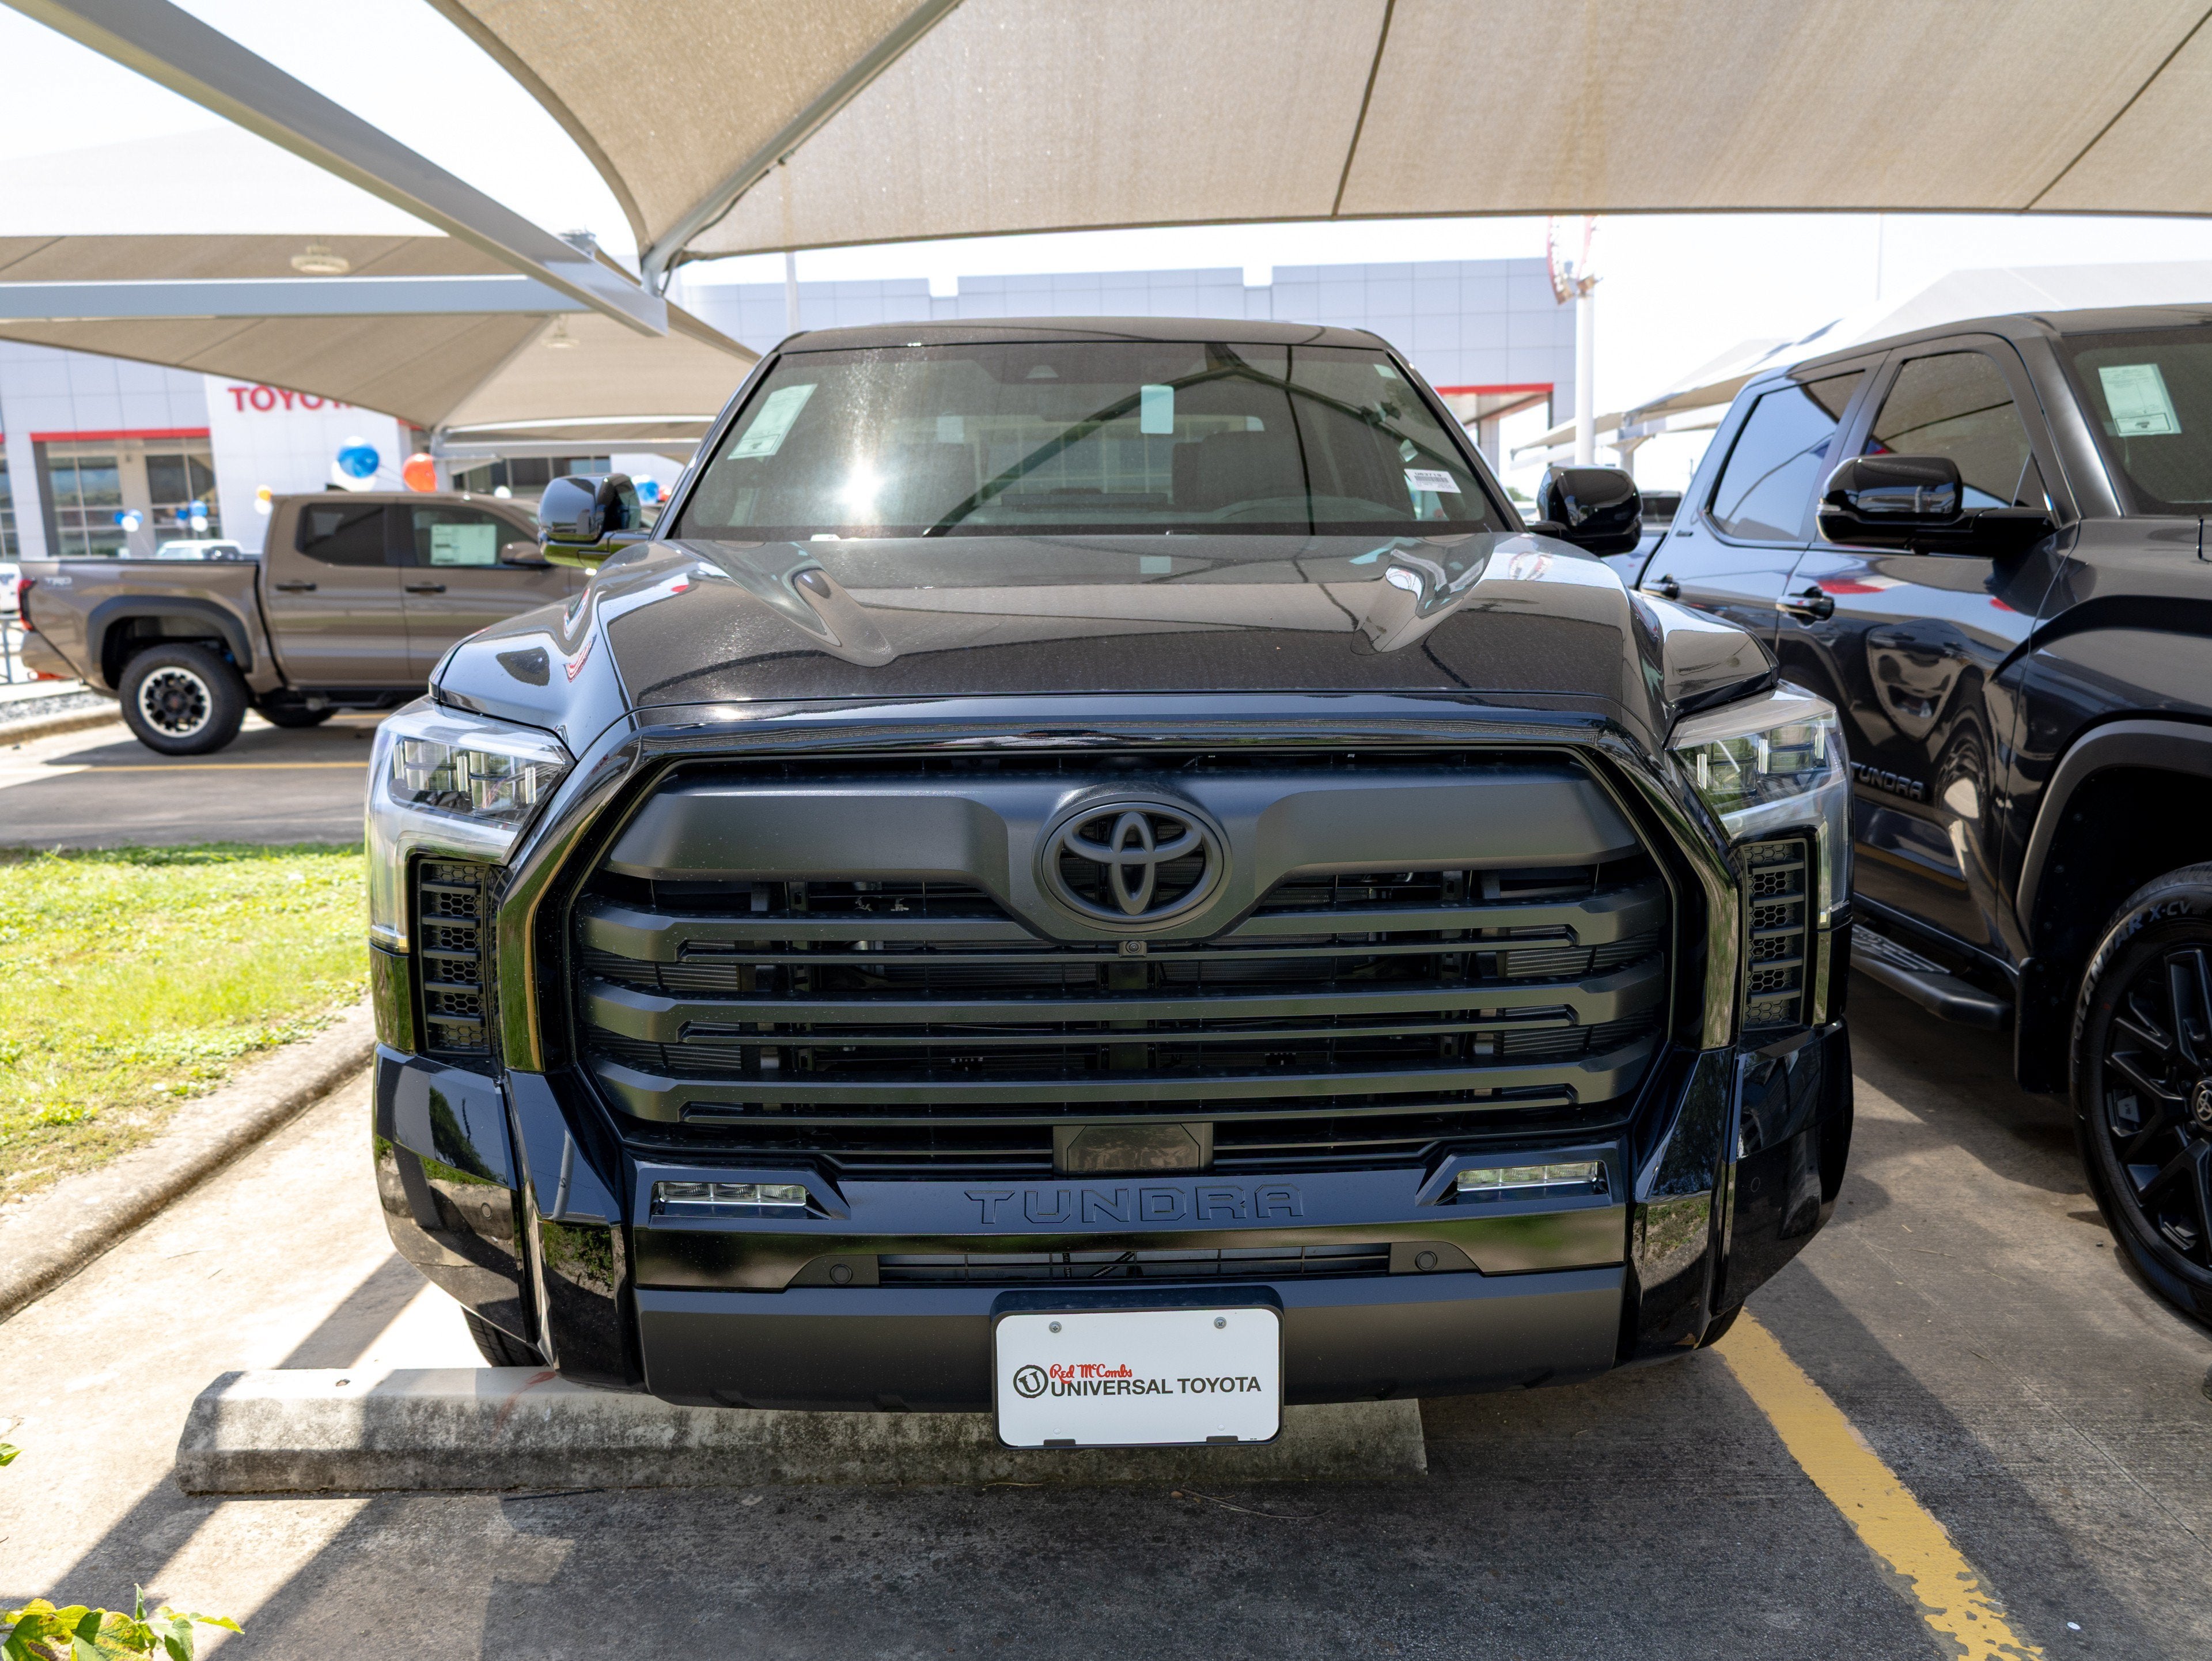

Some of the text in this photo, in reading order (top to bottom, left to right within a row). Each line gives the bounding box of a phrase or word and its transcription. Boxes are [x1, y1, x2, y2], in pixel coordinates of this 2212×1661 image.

[228, 384, 353, 411] TOYO
[964, 1184, 1304, 1225] TUNDRA
[1050, 1363, 1132, 1384] Red McCombs
[1051, 1376, 1262, 1397] UNIVERSAL TOYOTA
